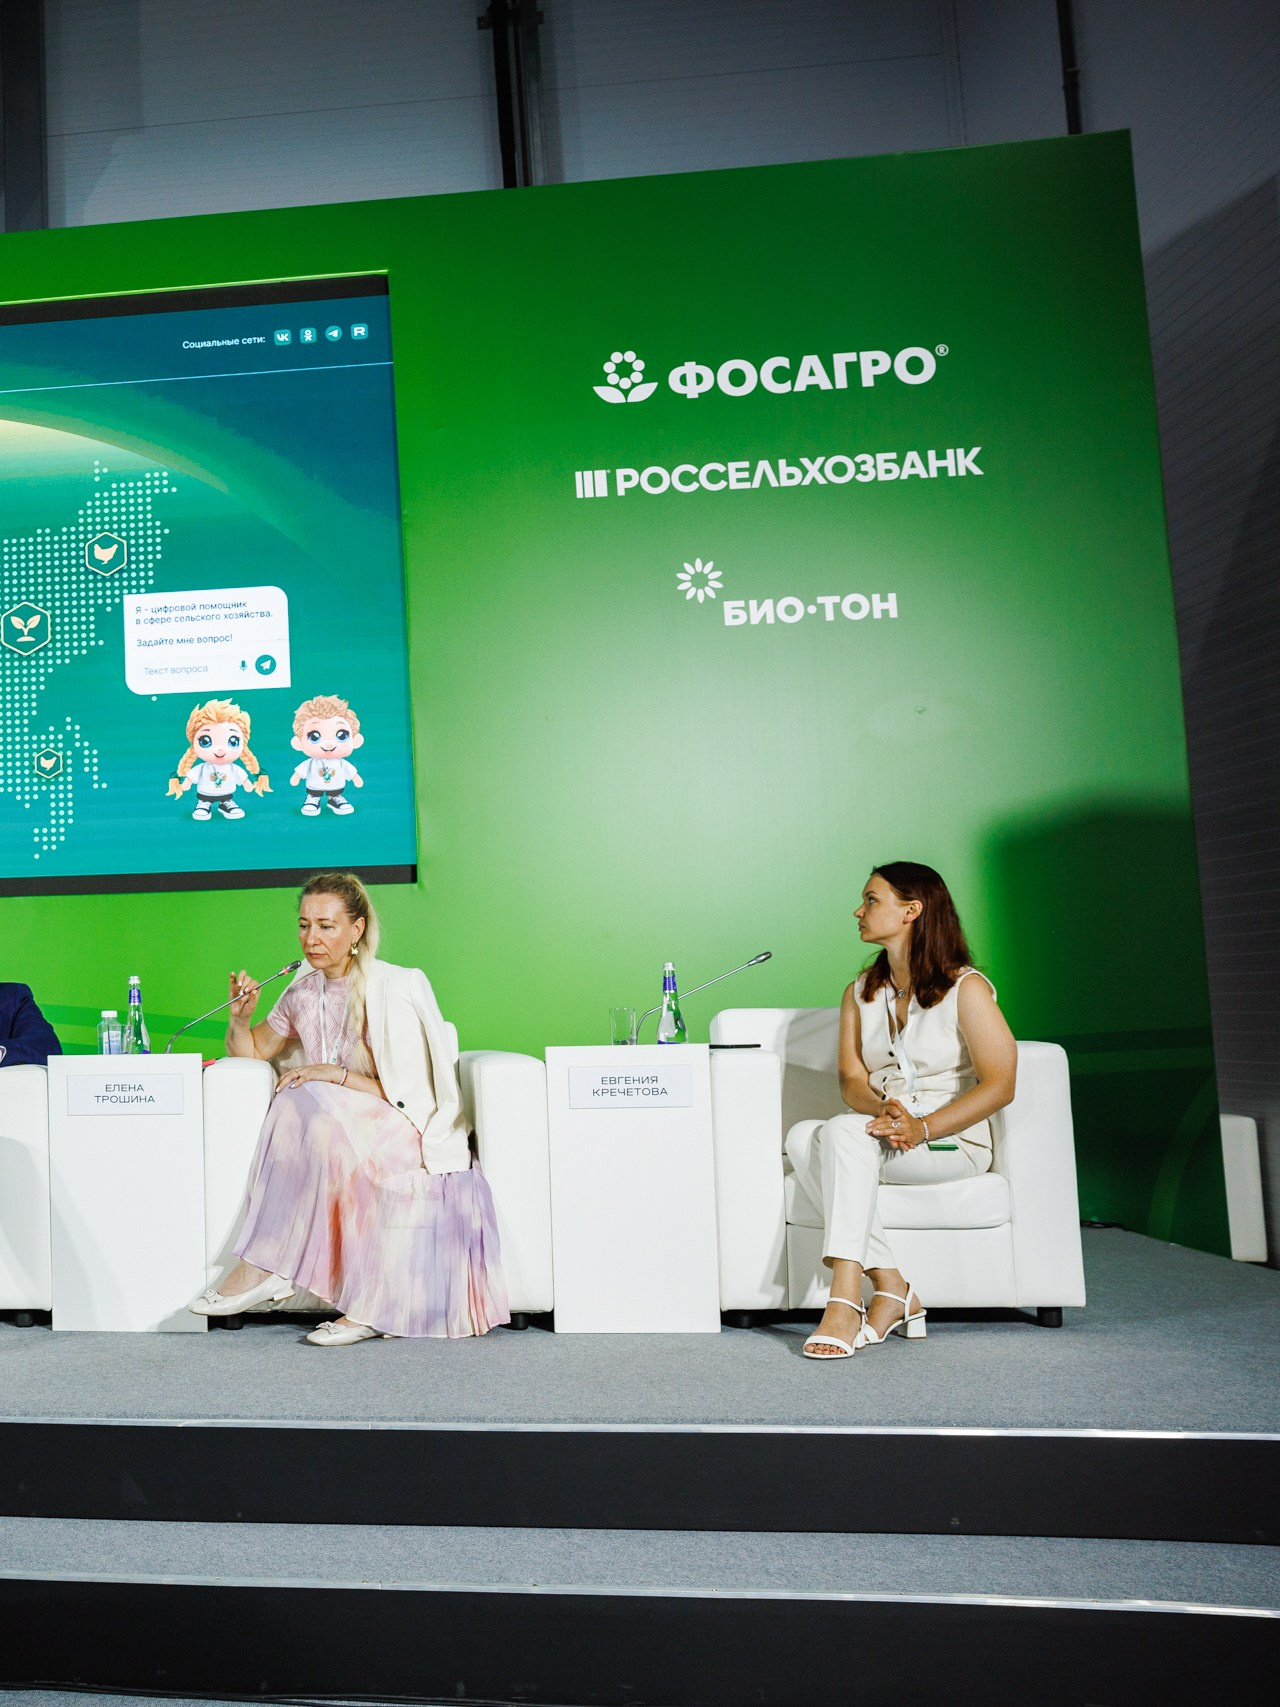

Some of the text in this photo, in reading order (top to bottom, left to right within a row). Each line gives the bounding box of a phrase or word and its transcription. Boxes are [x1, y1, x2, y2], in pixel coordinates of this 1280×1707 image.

[182, 335, 266, 349] Социальные сети:
[616, 446, 984, 496] РОССЕЛЬХОЗБАНК
[135, 606, 141, 614] Я
[151, 603, 197, 614] цифровой
[199, 601, 247, 611] помощник
[143, 616, 171, 626] сфере
[174, 613, 221, 623] сельского
[136, 634, 233, 648] Задайте мне вопрос!
[144, 665, 208, 676] Текст вопроса
[601, 1076, 658, 1085] ЕВГЕНИЯ
[105, 1084, 144, 1092] ЕЛЕНА
[592, 1087, 668, 1097] КРЕЧЕТОВА
[94, 1095, 155, 1104] ТРОШИНА
